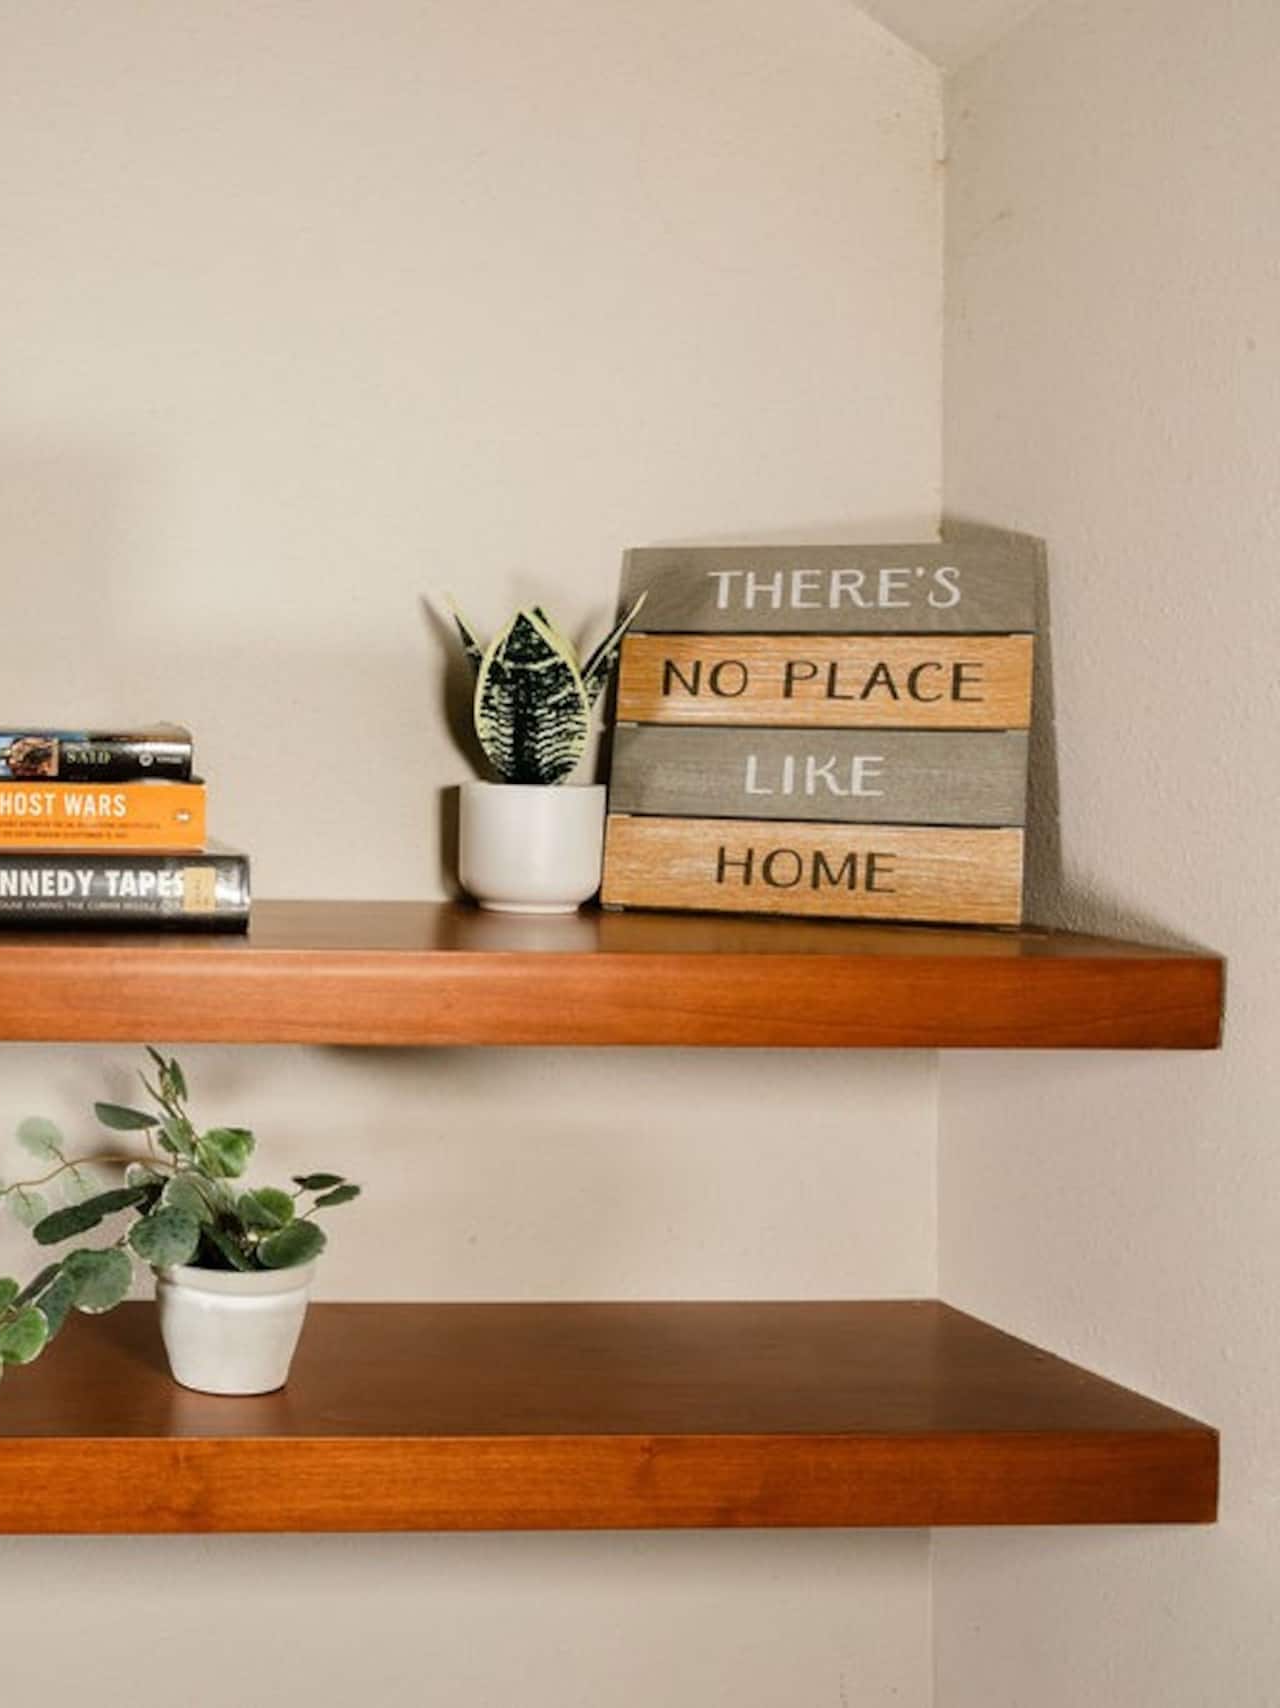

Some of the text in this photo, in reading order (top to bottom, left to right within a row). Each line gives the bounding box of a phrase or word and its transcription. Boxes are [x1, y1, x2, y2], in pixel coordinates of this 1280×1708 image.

[707, 567, 961, 609] THERE'S
[661, 659, 985, 702] NO PLACE
[66, 751, 112, 765] SAID
[745, 755, 886, 796] LIKE
[63, 793, 127, 818] WARS
[103, 869, 185, 898] TAPES
[715, 846, 898, 894] HOME
